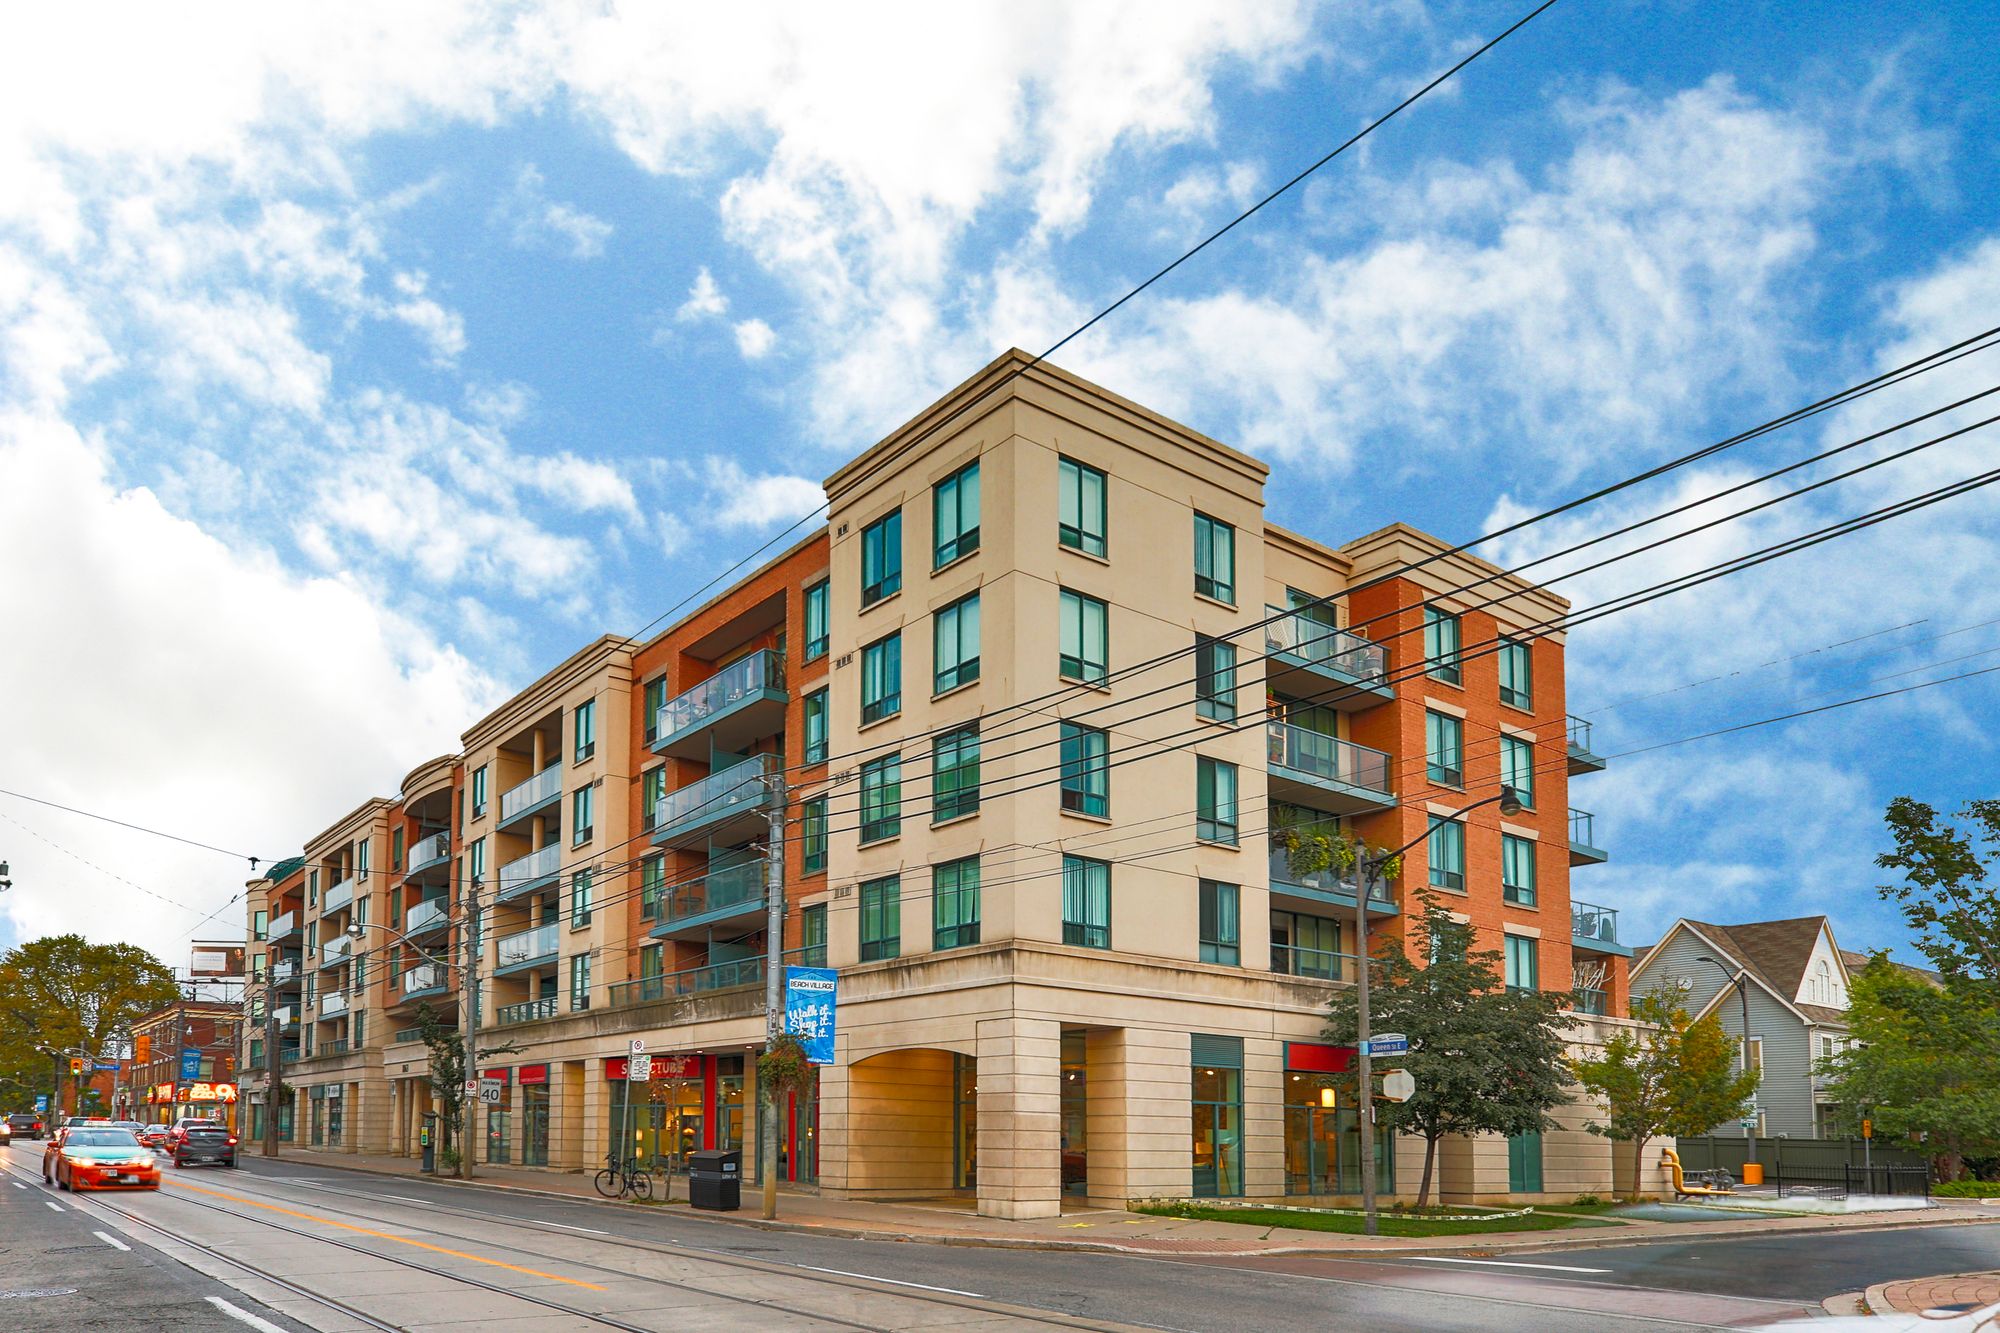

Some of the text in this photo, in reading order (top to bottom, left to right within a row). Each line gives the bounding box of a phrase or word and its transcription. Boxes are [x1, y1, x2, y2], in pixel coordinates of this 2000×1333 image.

[810, 982, 833, 990] VILLAGE
[789, 1004, 818, 1020] Walk
[820, 1004, 832, 1015] it.
[790, 1017, 818, 1032] Shop
[820, 1014, 832, 1026] it.
[818, 1028, 828, 1037] it.
[1372, 1043, 1390, 1051] Queen
[1397, 1042, 1401, 1050] E
[481, 1088, 500, 1101] 40
